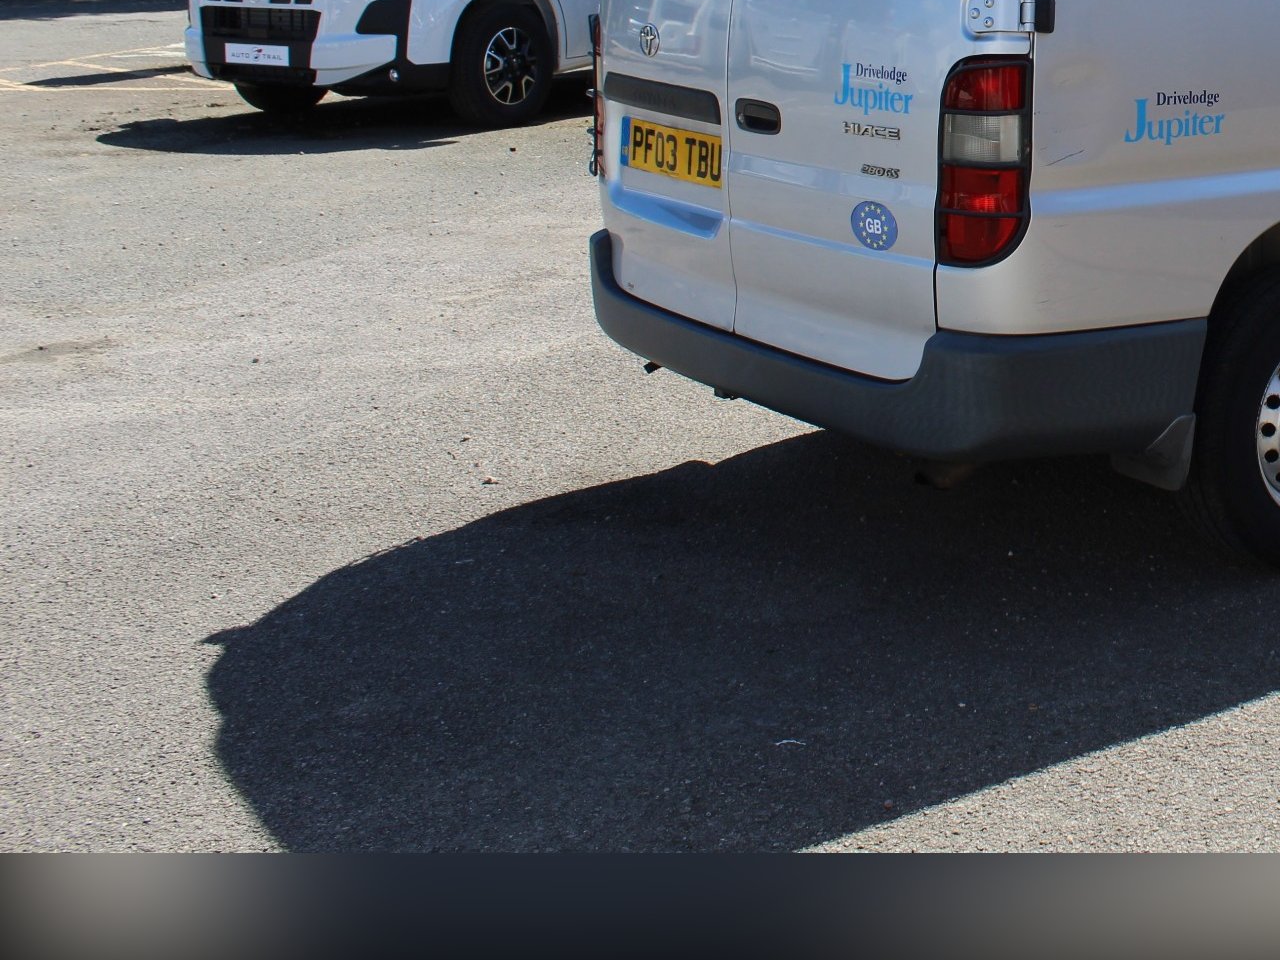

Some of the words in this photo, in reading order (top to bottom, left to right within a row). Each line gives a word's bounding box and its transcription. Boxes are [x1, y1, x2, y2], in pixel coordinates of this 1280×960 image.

[262, 53, 283, 61] TRAIL
[856, 62, 908, 86] Drivelodge
[833, 63, 914, 116] Jupiter
[1156, 89, 1220, 108] Drivelodge
[842, 121, 901, 141] HIACE
[1124, 98, 1226, 146] Jupiter
[632, 125, 678, 172] PF03
[685, 137, 722, 182] TBU
[865, 217, 882, 235] GB
